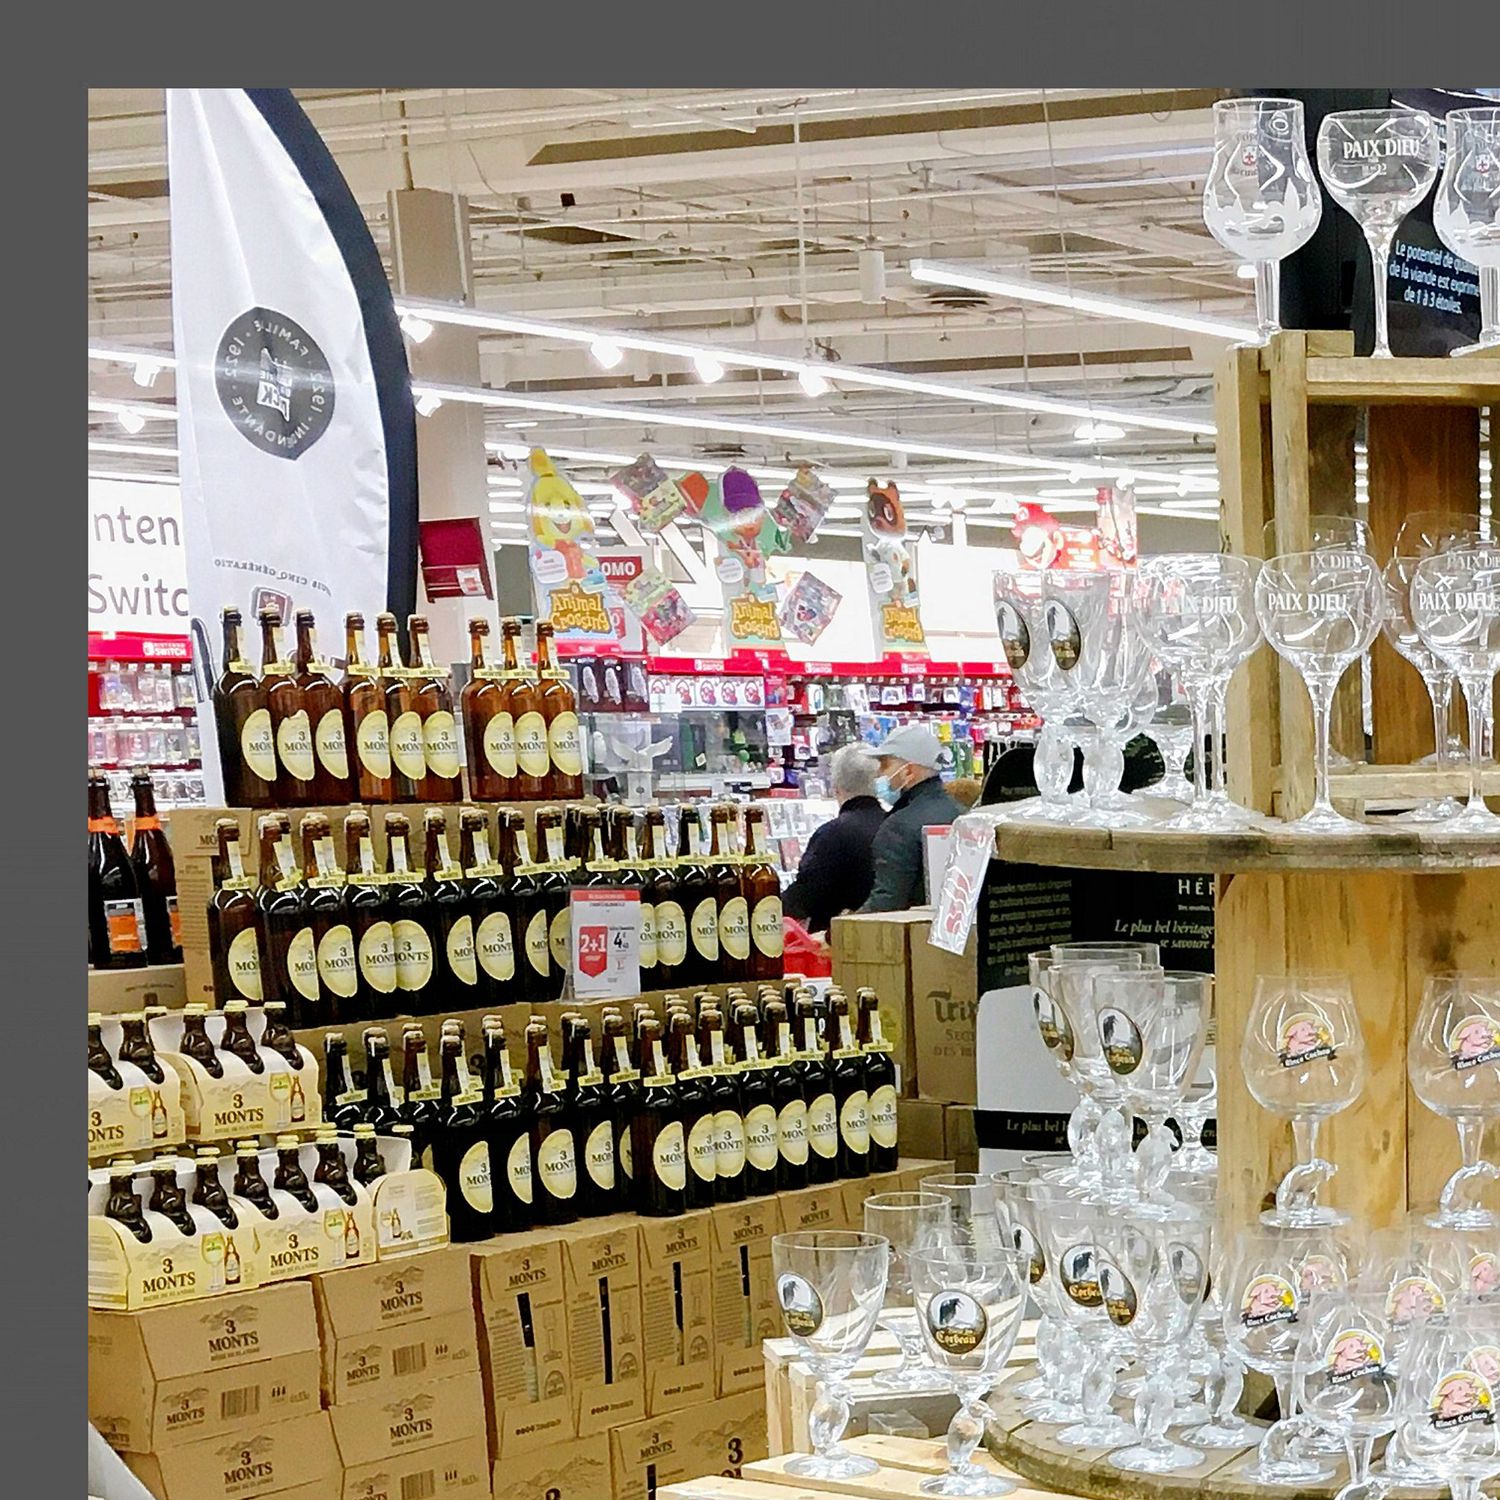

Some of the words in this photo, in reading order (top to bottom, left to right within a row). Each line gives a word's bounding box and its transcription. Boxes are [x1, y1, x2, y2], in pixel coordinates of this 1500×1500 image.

[1343, 141, 1380, 158] PAIX
[1385, 138, 1420, 156] DIEU
[1395, 239, 1406, 256] Le
[553, 592, 602, 611] Animal
[1268, 593, 1302, 611] PAIX
[1307, 594, 1347, 612] DIEU
[1419, 593, 1450, 610] PAIX
[551, 612, 610, 631] Crossing
[1130, 919, 1151, 936] plus
[1154, 919, 1170, 933] bel
[580, 934, 606, 953] 2+1
[233, 1094, 244, 1108] 3
[91, 1112, 102, 1127] 3
[214, 1108, 264, 1125] MONTS
[288, 1234, 299, 1249] 3
[162, 1259, 174, 1274] 3
[270, 1247, 319, 1268] MONTS
[142, 1272, 196, 1294] MONTS
[395, 1282, 404, 1293] 3
[380, 1292, 423, 1311] MONTS
[226, 1320, 236, 1333] 3
[208, 1332, 259, 1352] MONTS
[936, 1331, 976, 1346] Corbeau
[359, 1355, 366, 1367] 3
[346, 1364, 380, 1381] MONTS
[166, 1407, 205, 1426] MONTS
[389, 1419, 432, 1439] MONTS
[727, 1437, 742, 1464] 3
[223, 1462, 273, 1484] MONTS
